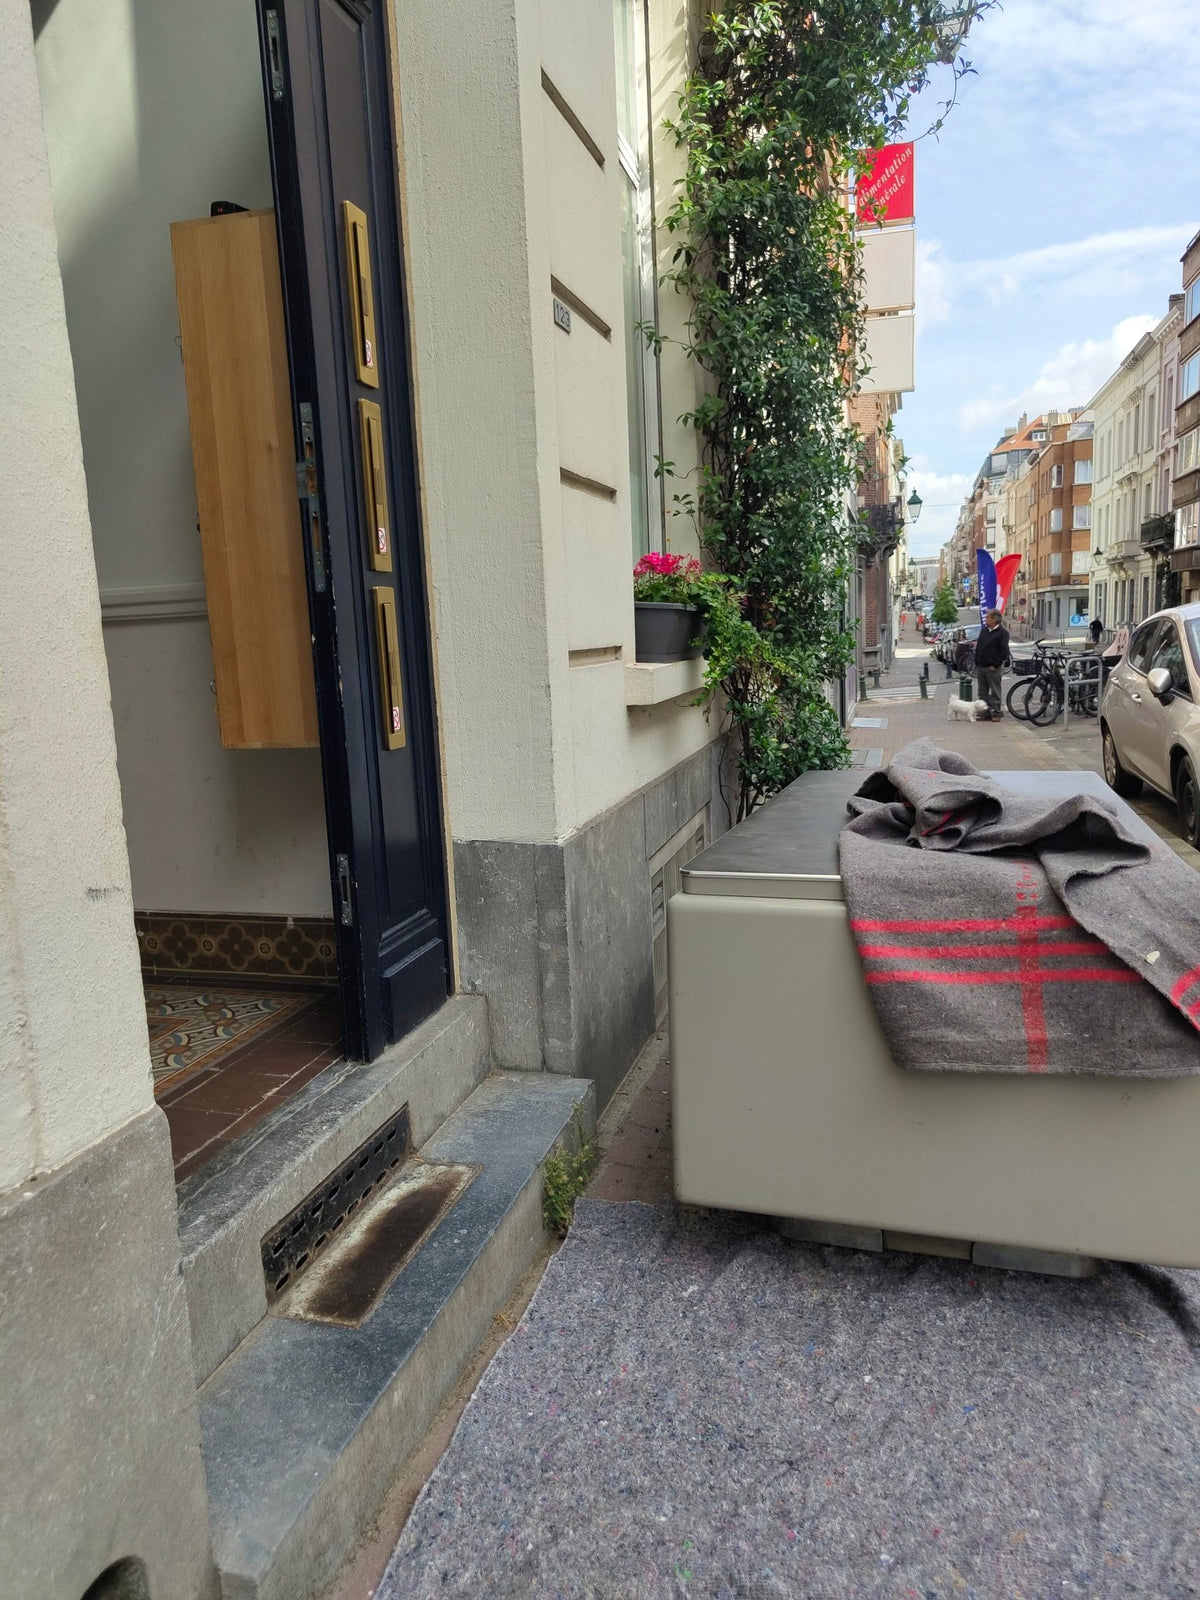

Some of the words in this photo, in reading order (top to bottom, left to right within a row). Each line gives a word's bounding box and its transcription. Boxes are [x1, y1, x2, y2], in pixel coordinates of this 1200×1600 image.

[859, 148, 912, 206] alimentation
[868, 175, 906, 215] nérale
[556, 303, 570, 327] 123
